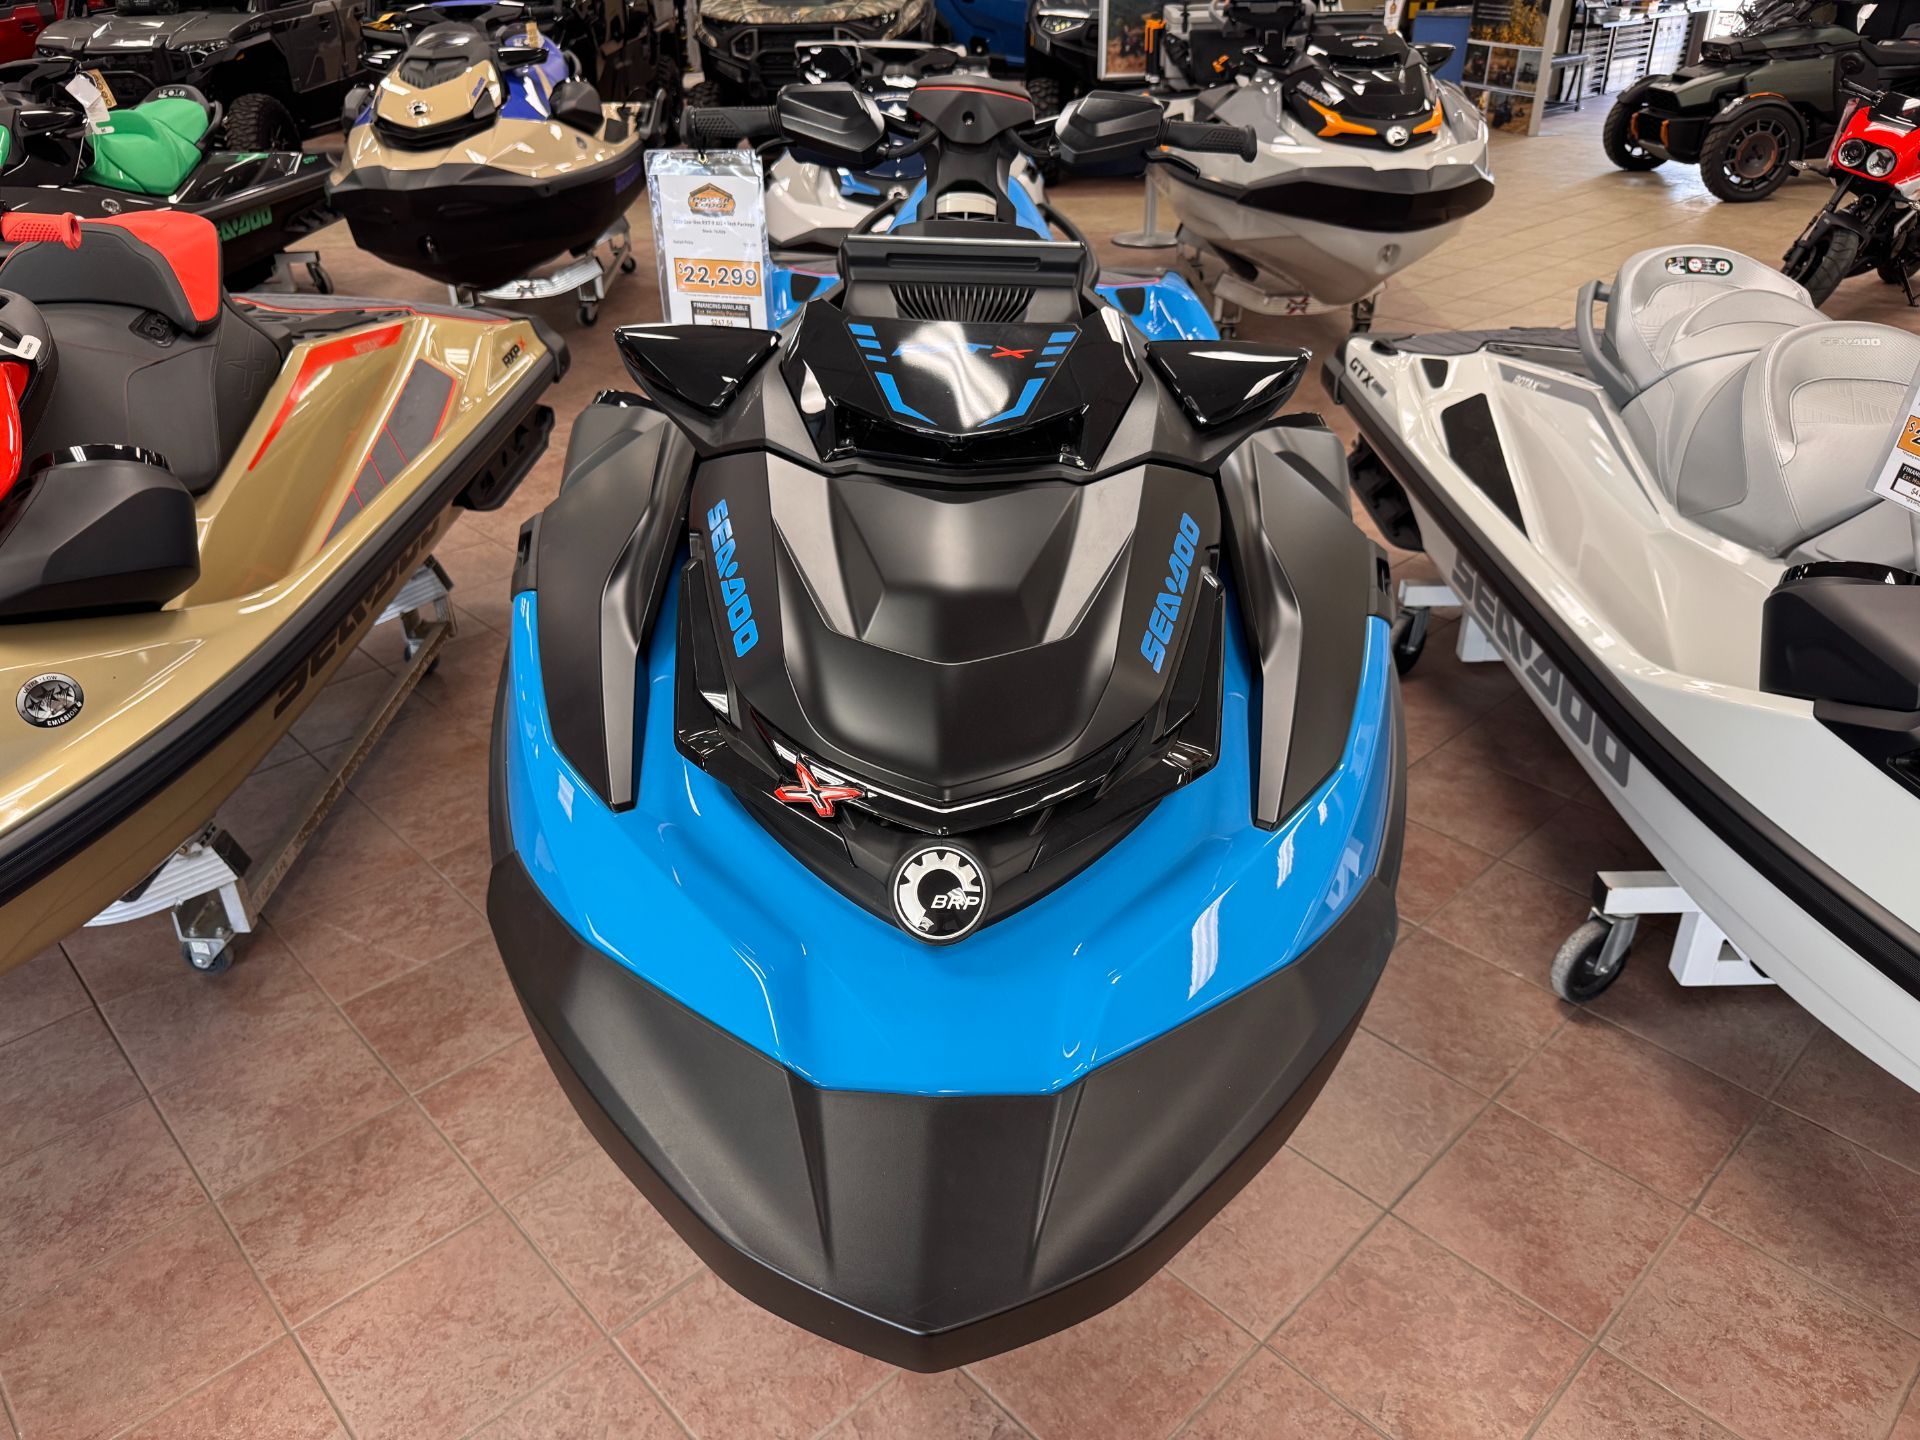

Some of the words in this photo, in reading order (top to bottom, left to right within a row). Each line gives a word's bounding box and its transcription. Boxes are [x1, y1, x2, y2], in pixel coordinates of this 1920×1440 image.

[678, 263, 757, 287] $22,299
[1350, 357, 1374, 389] GTX
[931, 894, 980, 911] BRP
